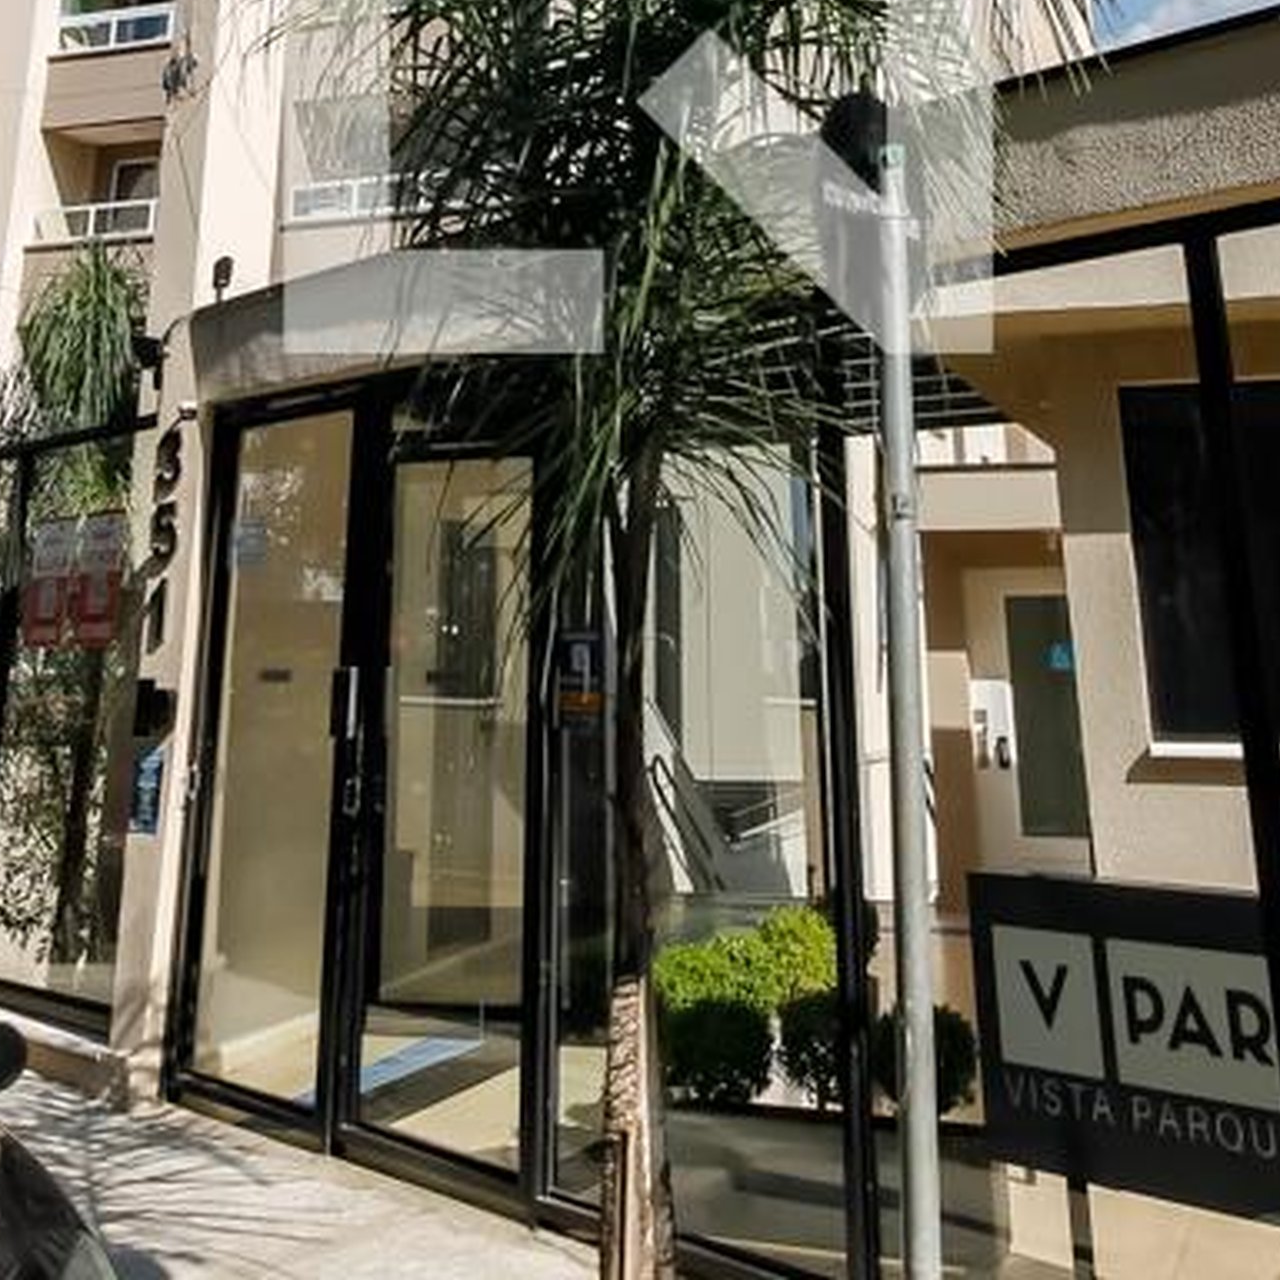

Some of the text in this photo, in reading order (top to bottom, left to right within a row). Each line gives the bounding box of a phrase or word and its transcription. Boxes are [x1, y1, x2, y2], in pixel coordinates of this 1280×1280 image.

[1019, 959, 1068, 1031] V
[1002, 1070, 1117, 1126] VISTA
[1130, 1094, 1278, 1160] PARQU
